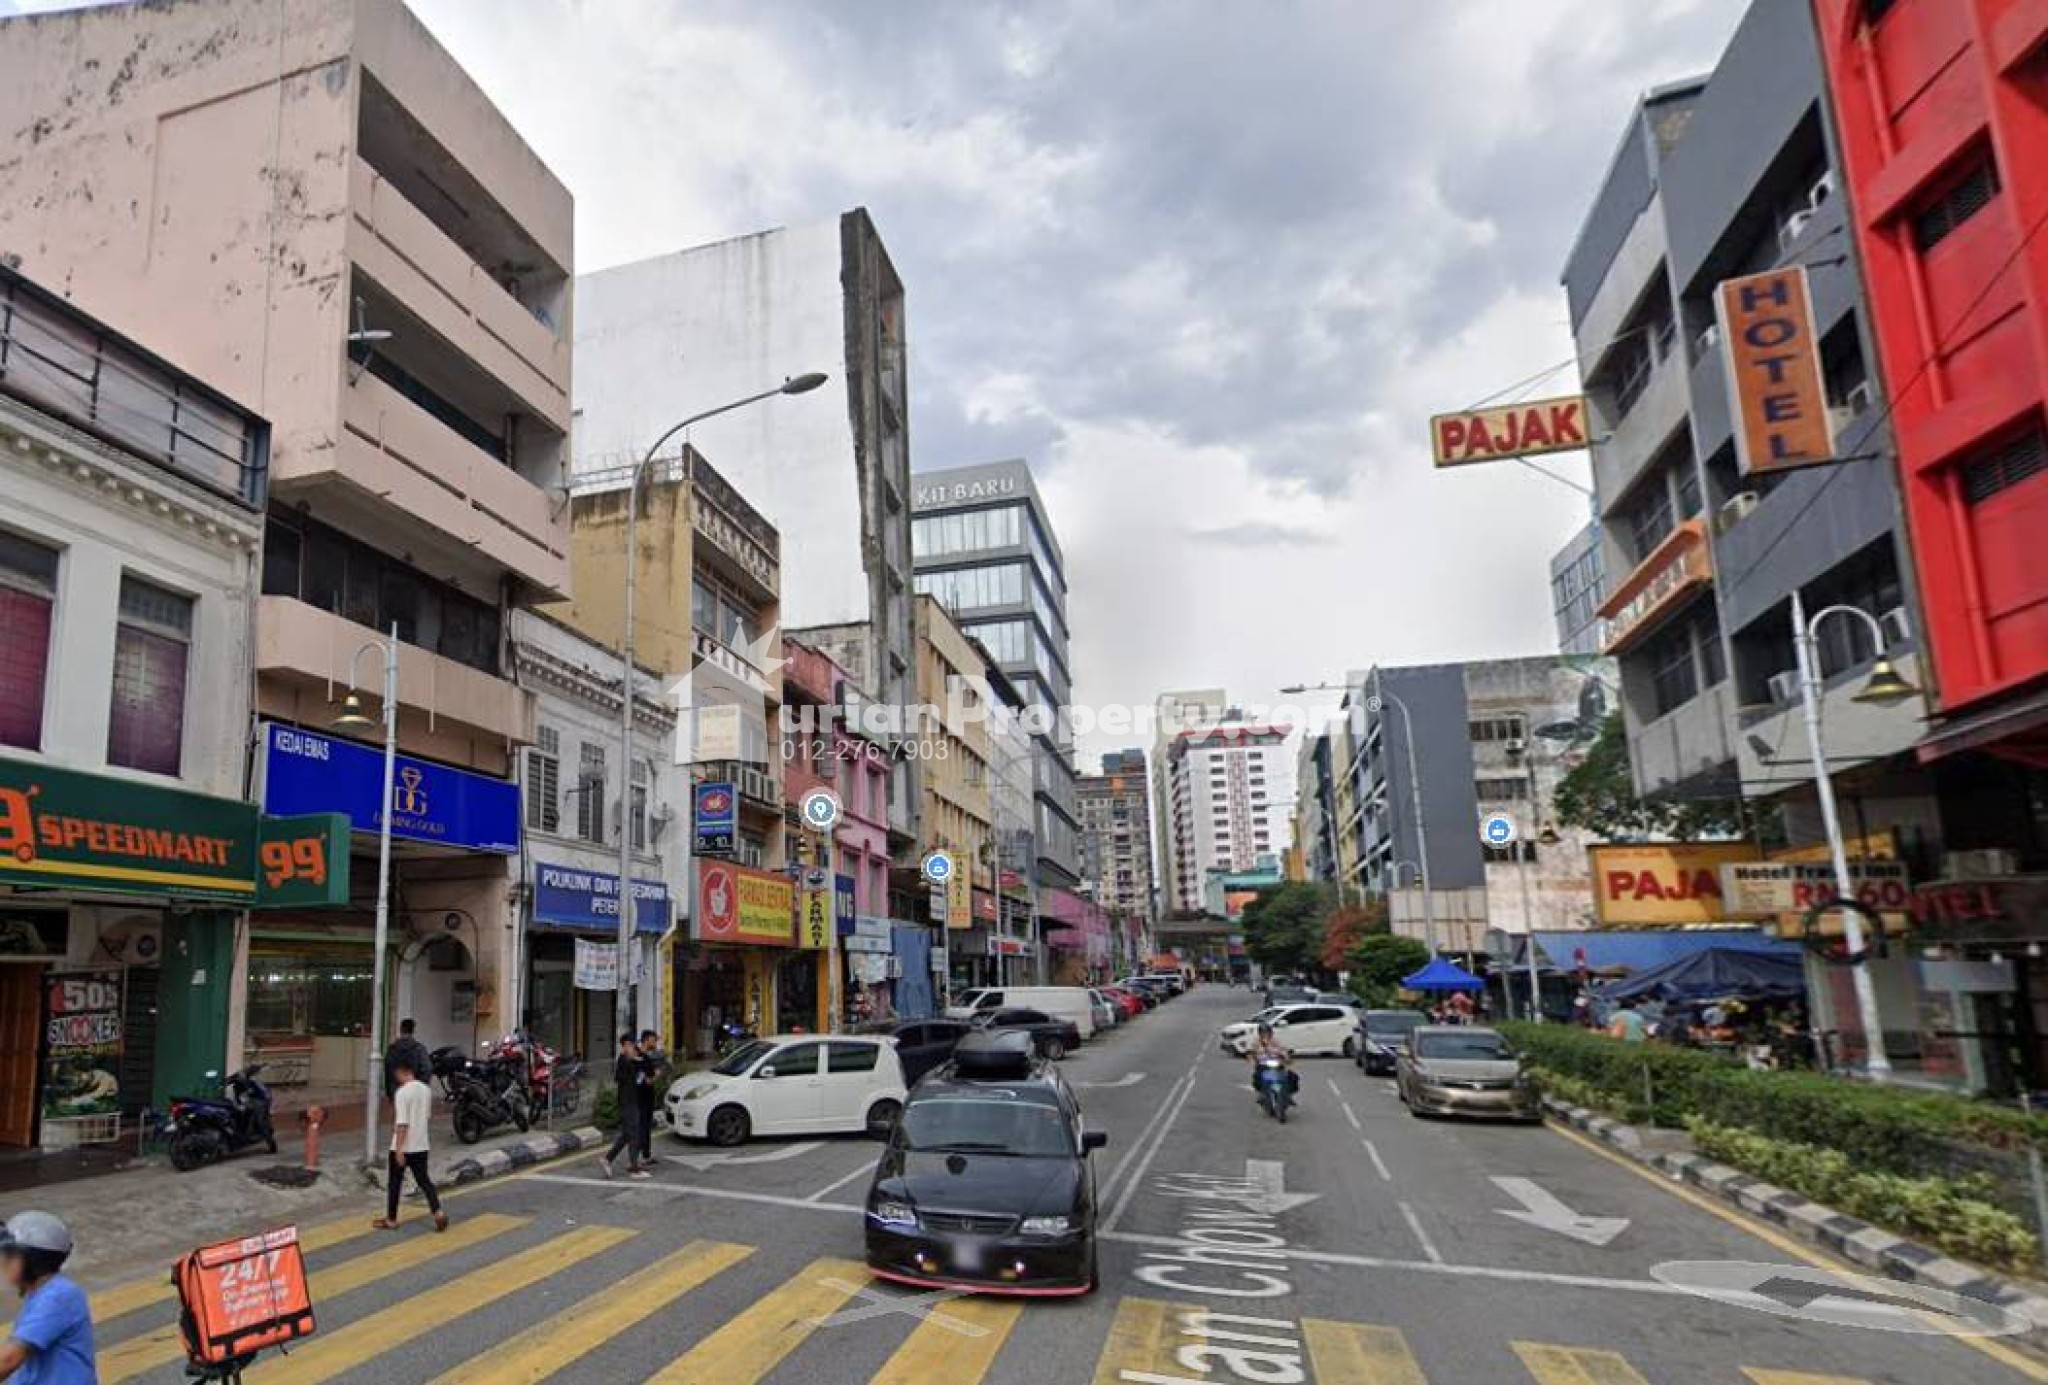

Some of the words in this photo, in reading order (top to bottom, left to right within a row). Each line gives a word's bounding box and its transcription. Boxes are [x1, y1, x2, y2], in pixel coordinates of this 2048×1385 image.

[1741, 279, 1805, 459] HOTEL
[1440, 404, 1582, 459] PAJAK
[955, 478, 1013, 499] BARU
[276, 729, 303, 754] KEDAI
[305, 737, 329, 761] EMAS
[38, 813, 230, 866] SPEEDMART
[261, 836, 326, 887] 99
[1735, 867, 1789, 879] Hotel
[594, 877, 613, 894] DAN
[1858, 879, 1905, 906] 60
[809, 892, 823, 946] FARMASI
[47, 1015, 122, 1045] SNOOKER
[220, 1250, 281, 1288] 24/7
